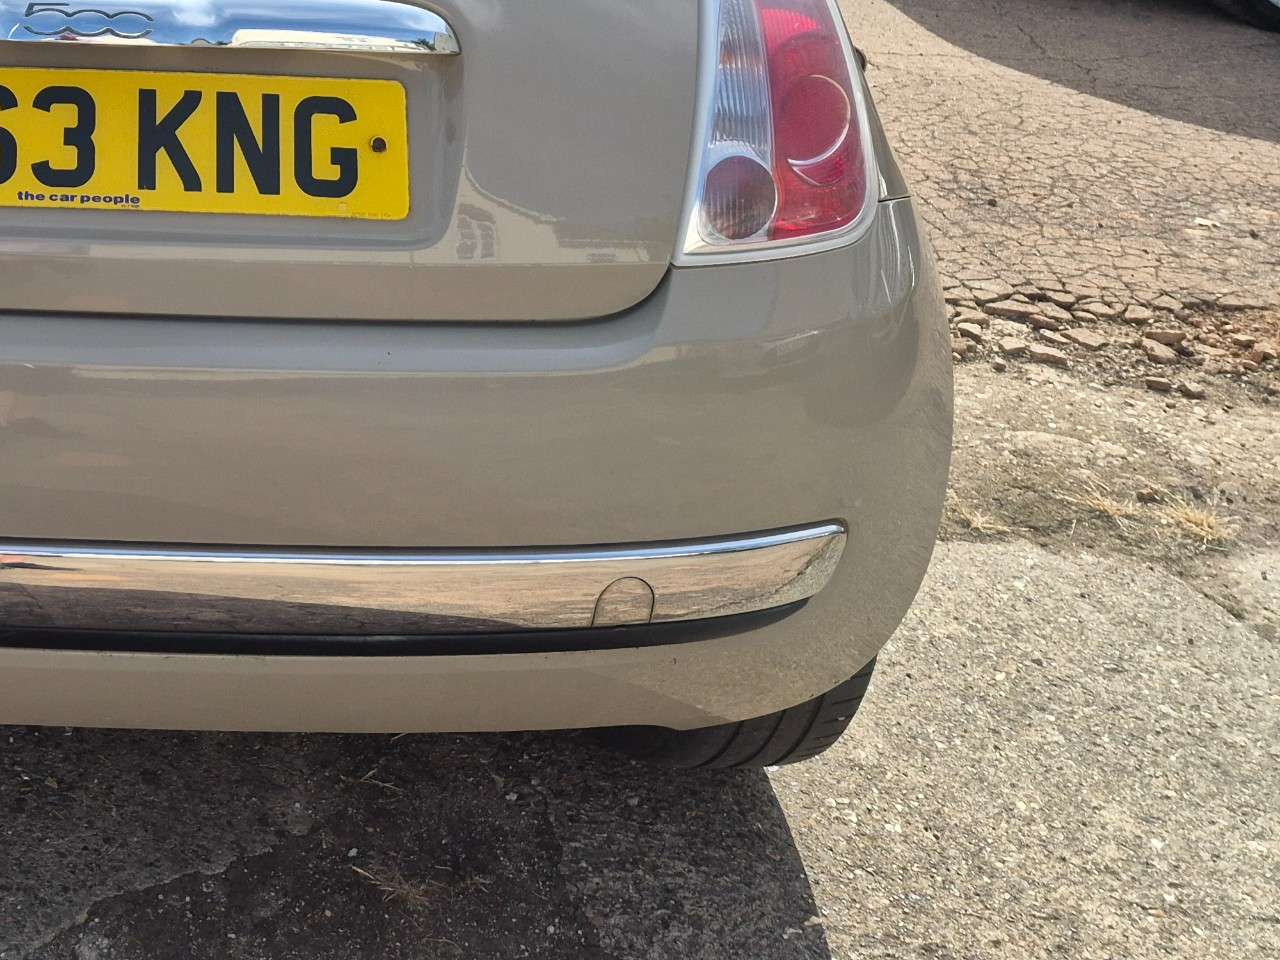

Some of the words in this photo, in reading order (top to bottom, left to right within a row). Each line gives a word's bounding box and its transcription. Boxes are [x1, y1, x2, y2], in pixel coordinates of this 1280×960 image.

[24, 2, 154, 39] 500
[137, 88, 359, 199] KNG
[17, 191, 46, 201] the
[49, 194, 78, 202] car
[80, 194, 140, 204] people
